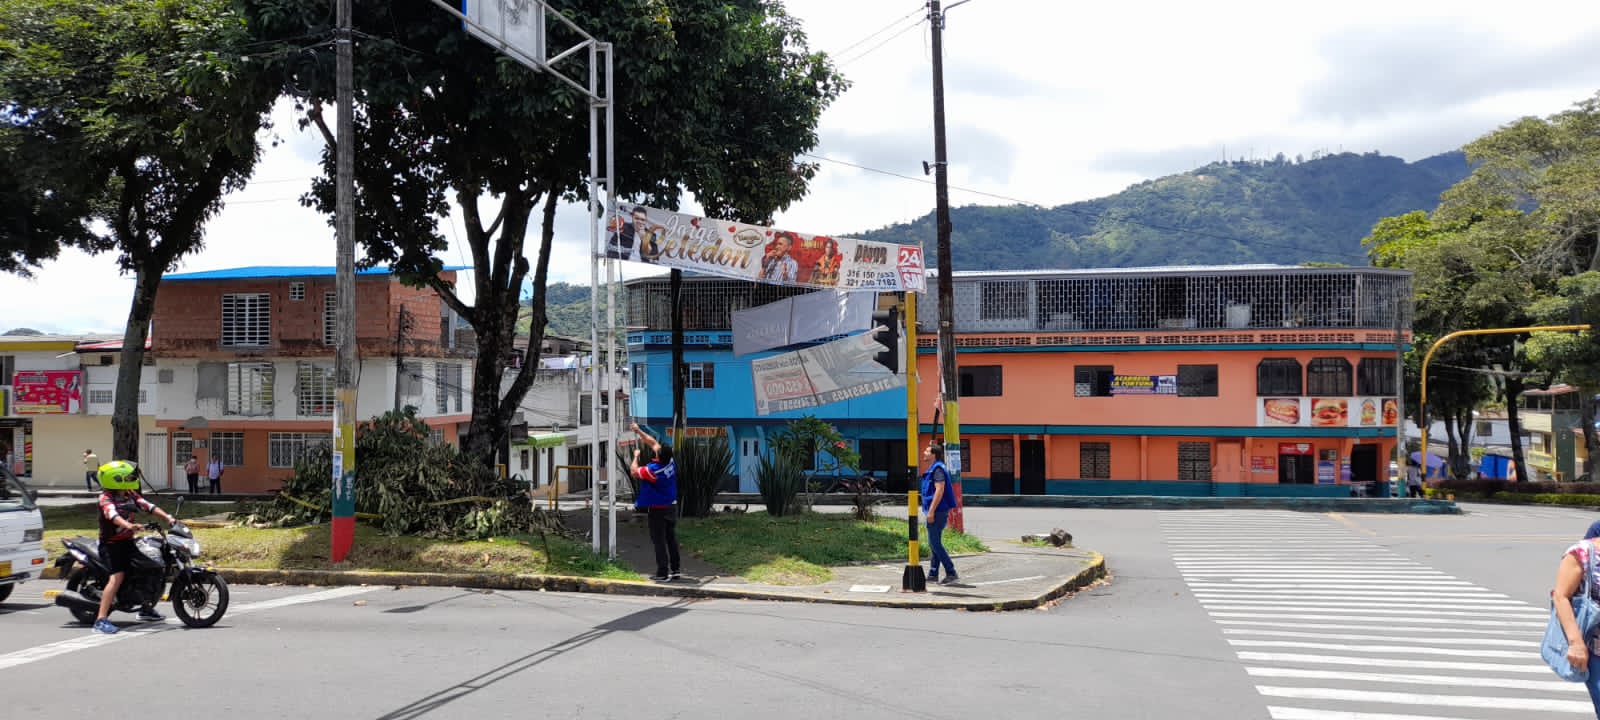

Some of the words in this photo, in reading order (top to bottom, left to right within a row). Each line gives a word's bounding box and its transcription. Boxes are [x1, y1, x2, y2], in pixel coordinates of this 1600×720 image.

[665, 214, 719, 245] Jorge
[899, 250, 921, 267] 24
[876, 278, 897, 287] 7182
